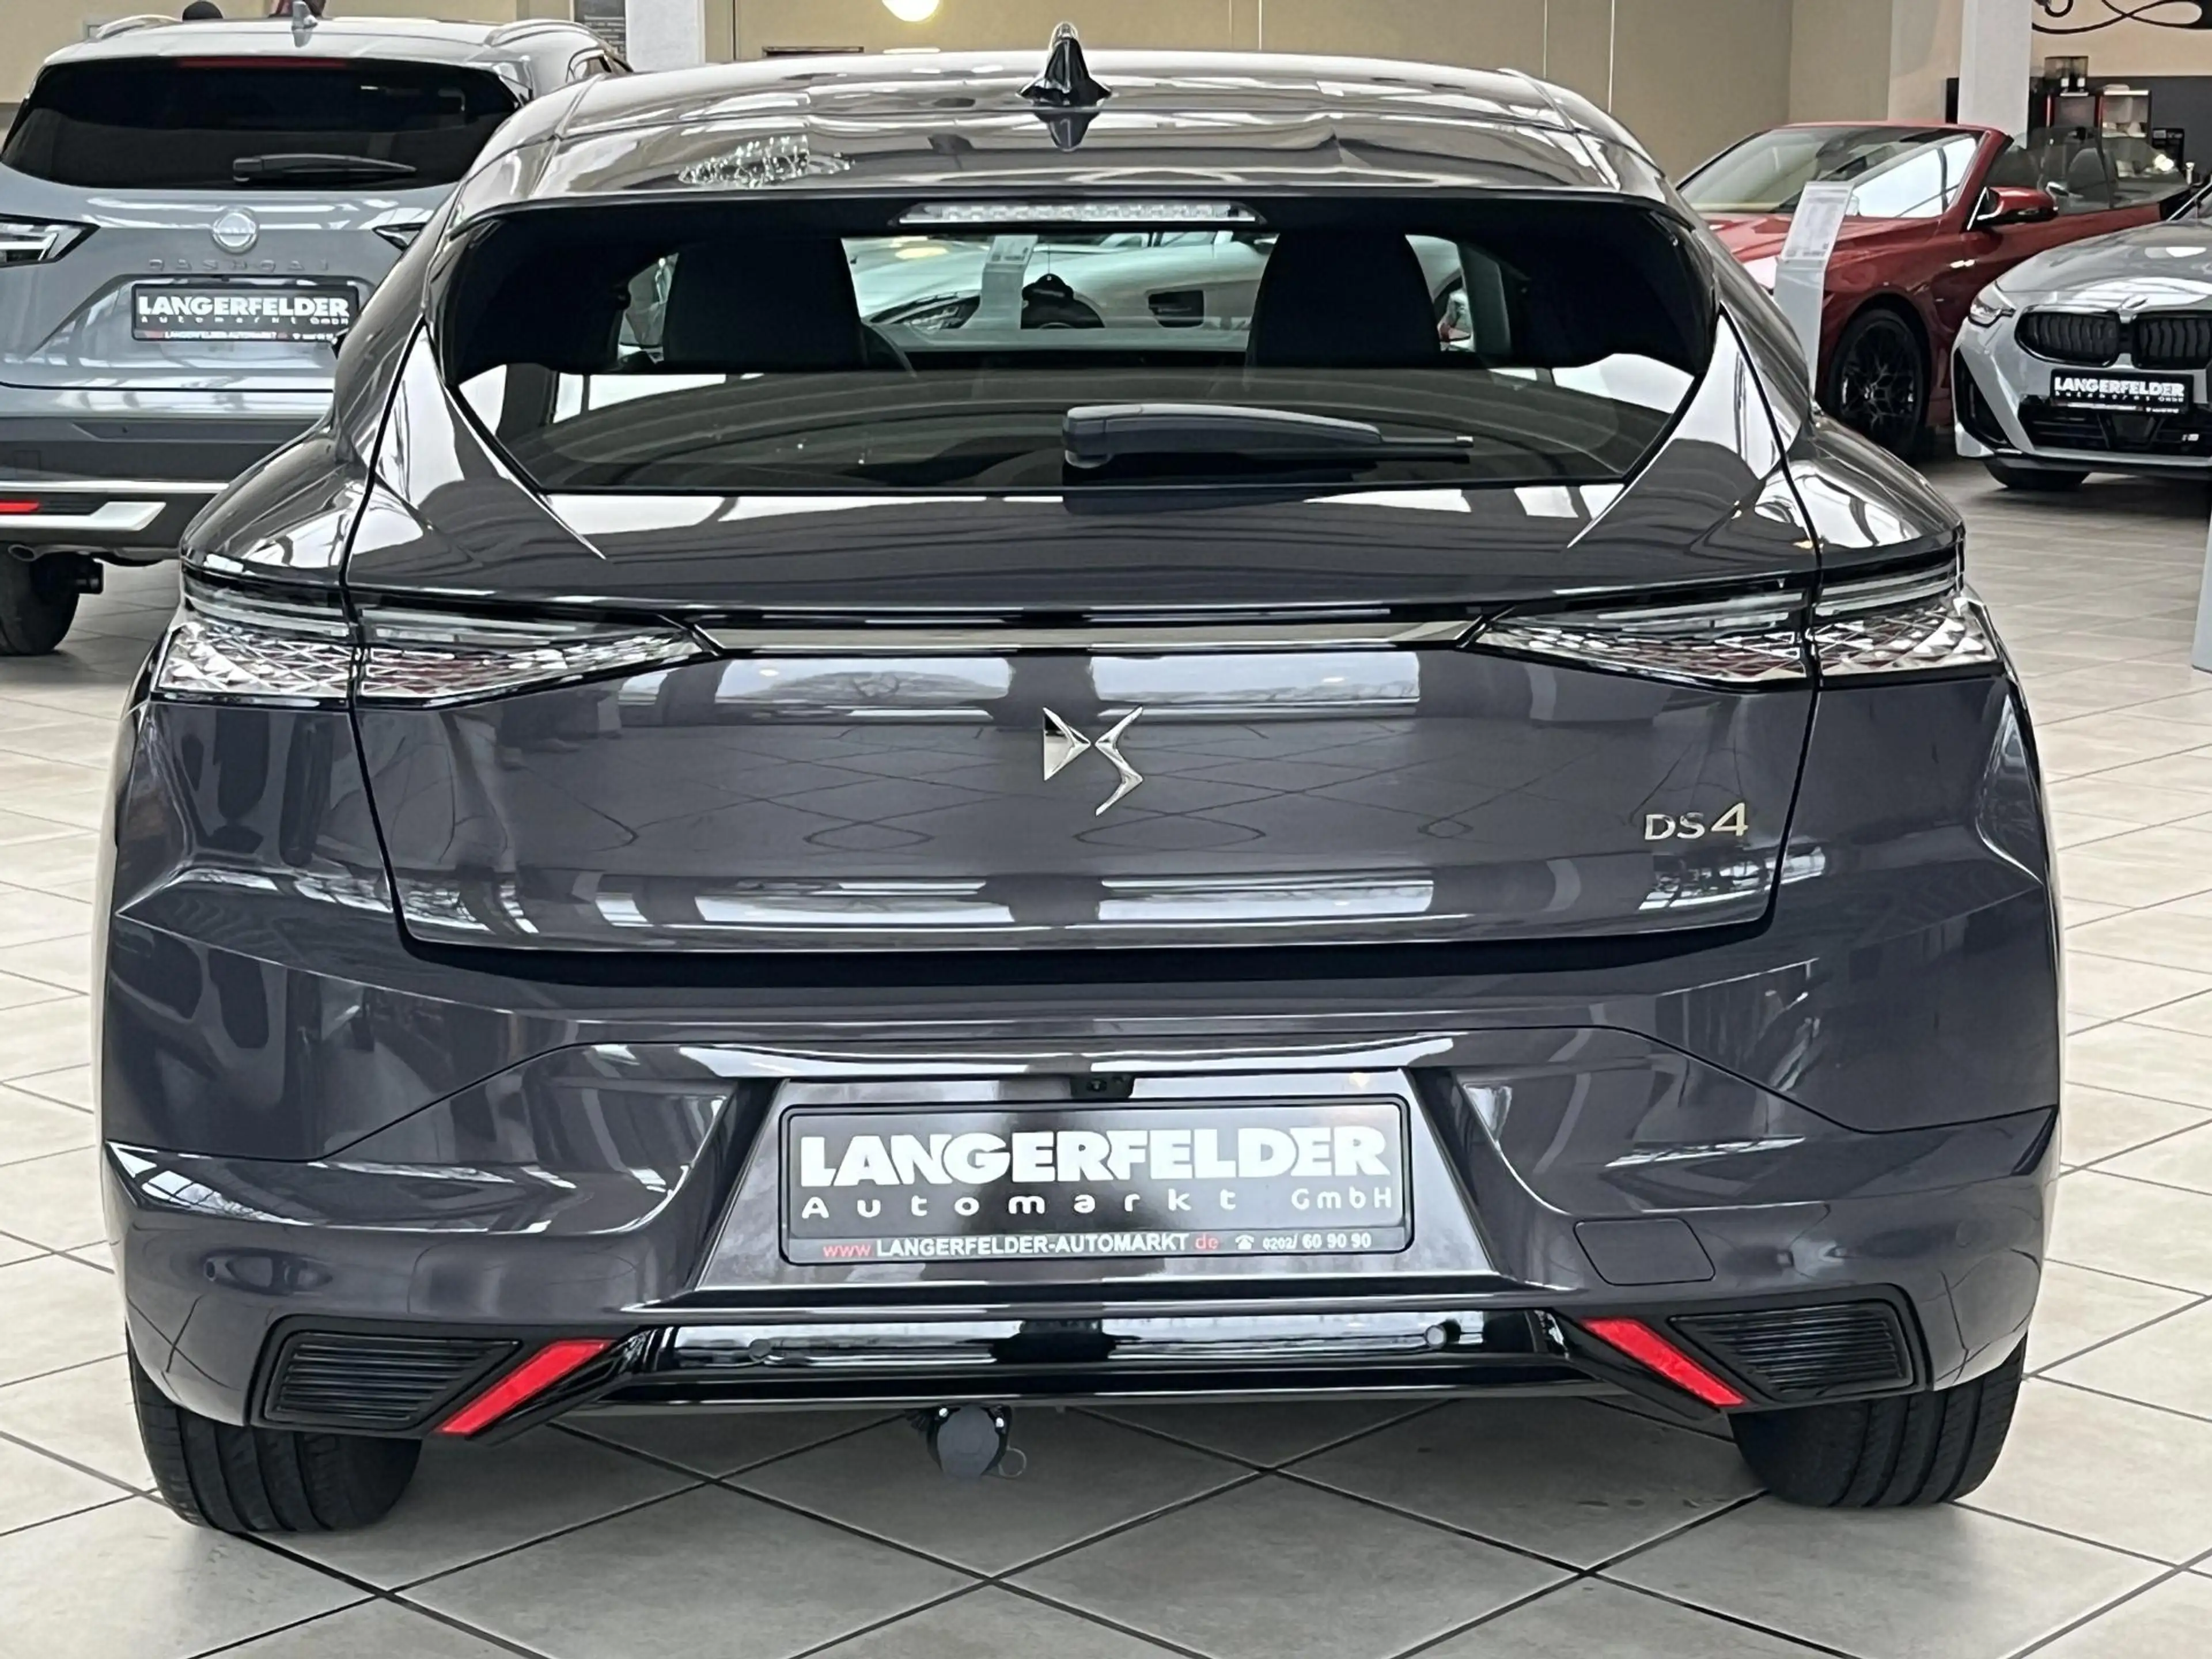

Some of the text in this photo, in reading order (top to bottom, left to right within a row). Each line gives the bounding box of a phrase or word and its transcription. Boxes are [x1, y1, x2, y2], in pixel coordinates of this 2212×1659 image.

[138, 296, 350, 317] LANGERFELDER
[2054, 377, 2185, 397] LANGERFELDER
[801, 1126, 1391, 1187] LANGERFELDER
[801, 1187, 1392, 1219] Automarkt GmbH
[1302, 1234, 1323, 1249] 60
[1327, 1233, 1347, 1249] 90
[1351, 1233, 1372, 1248] 90
